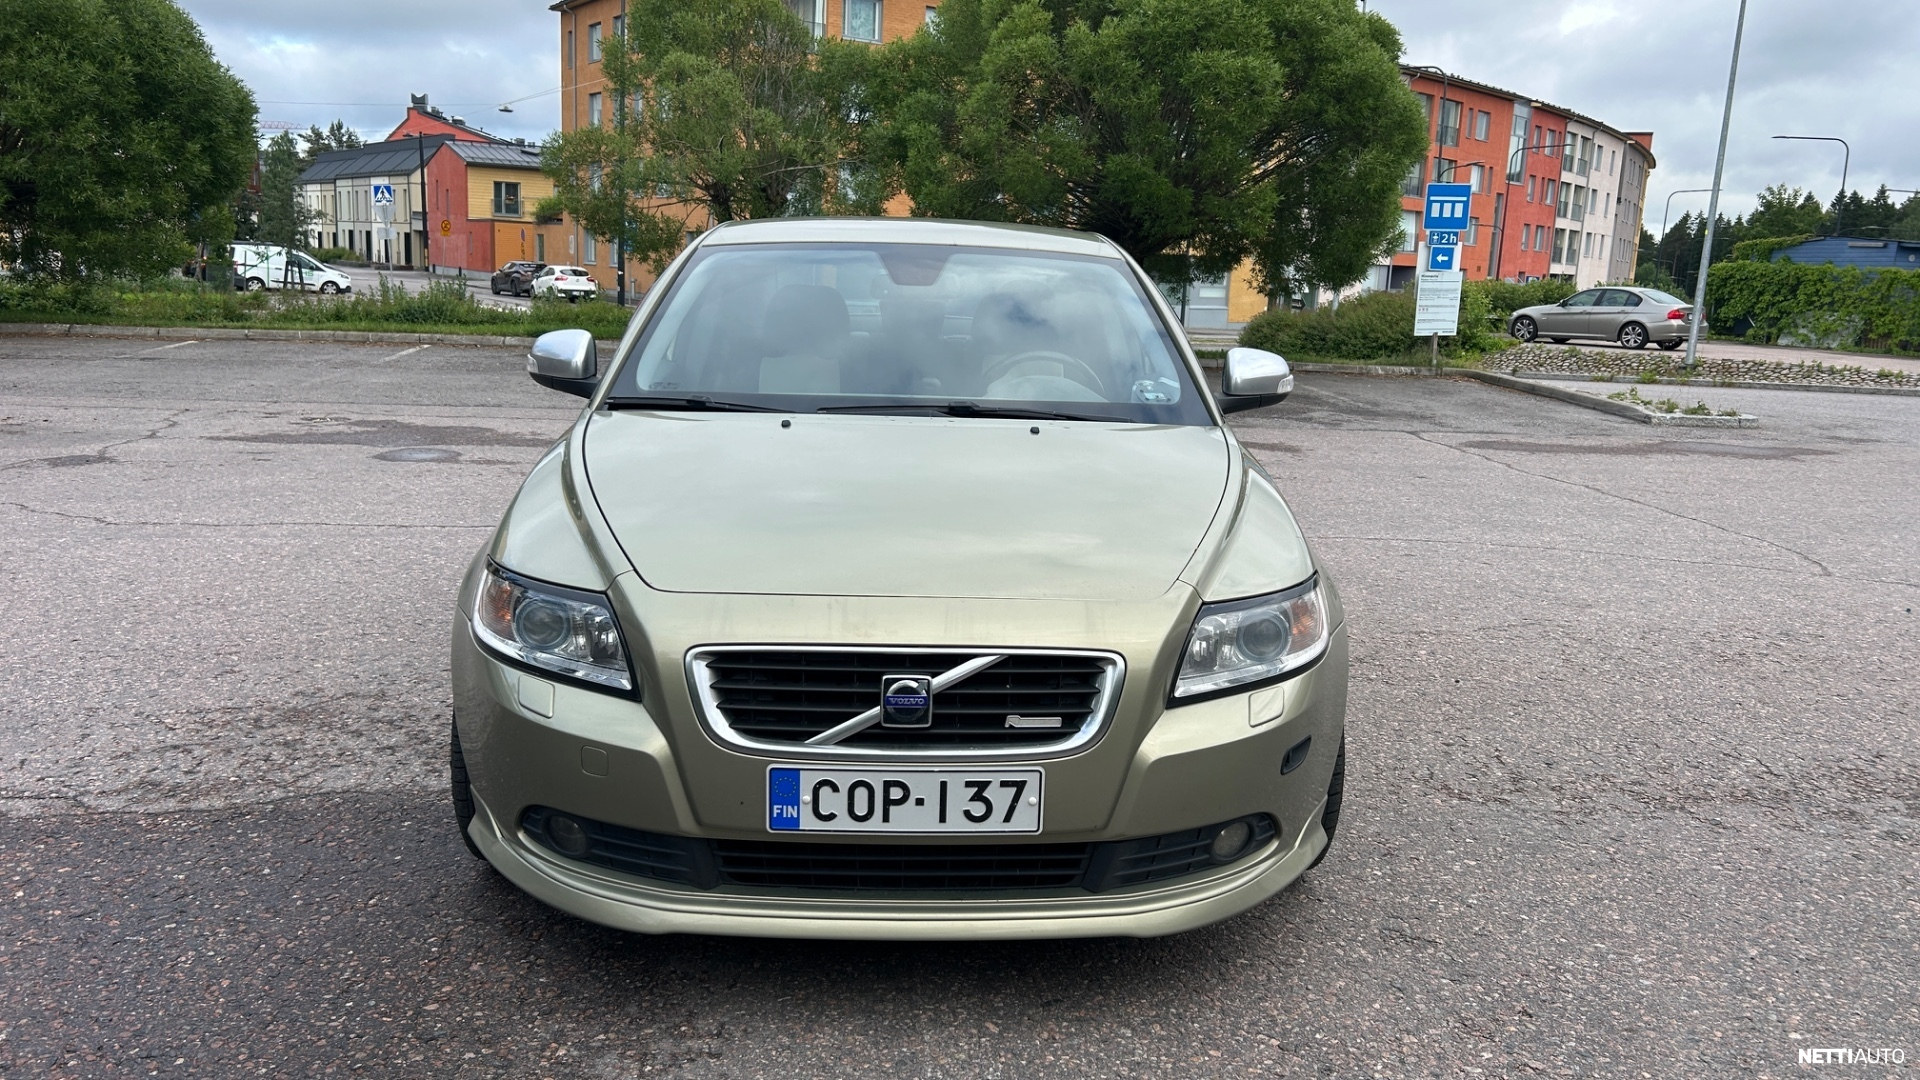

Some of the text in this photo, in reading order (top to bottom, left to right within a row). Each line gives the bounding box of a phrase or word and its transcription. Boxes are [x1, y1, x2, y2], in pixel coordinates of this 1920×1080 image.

[888, 697, 925, 705] VOLVO
[811, 778, 1028, 824] COP-137
[772, 804, 798, 818] FIN
